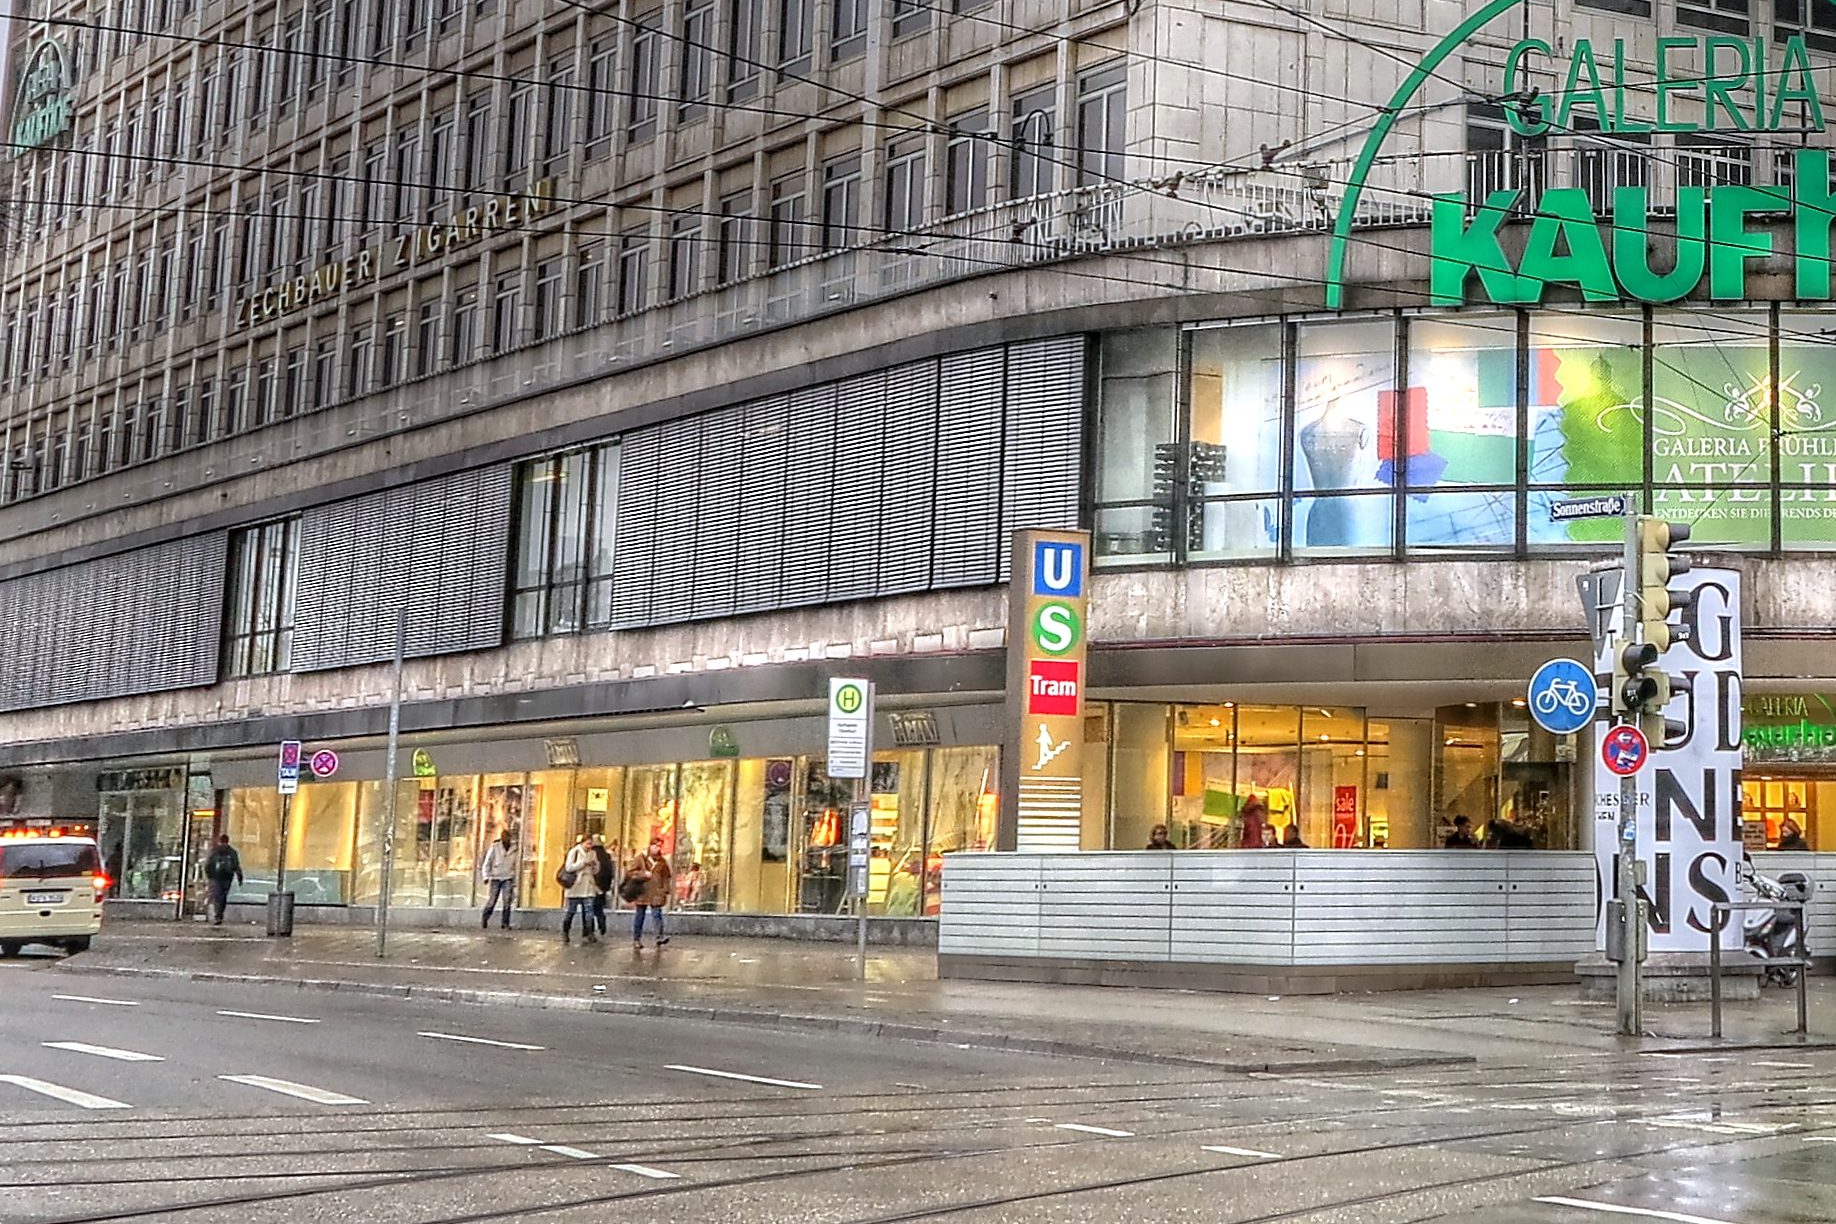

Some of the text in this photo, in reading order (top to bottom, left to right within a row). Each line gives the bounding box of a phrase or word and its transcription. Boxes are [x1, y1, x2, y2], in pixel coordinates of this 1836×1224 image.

[1504, 35, 1824, 135] GALERIA
[236, 180, 548, 326] ZECHBAUER ZIGARREN
[1654, 438, 1752, 457] GALERIA
[1552, 498, 1622, 518] Sonnenstraße
[1656, 508, 1728, 520] ENTDECKEN
[1731, 508, 1748, 519] SIE
[1774, 508, 1821, 520] RENDS
[1043, 548, 1072, 590] U
[1039, 605, 1072, 652] S
[1030, 674, 1076, 697] Tram
